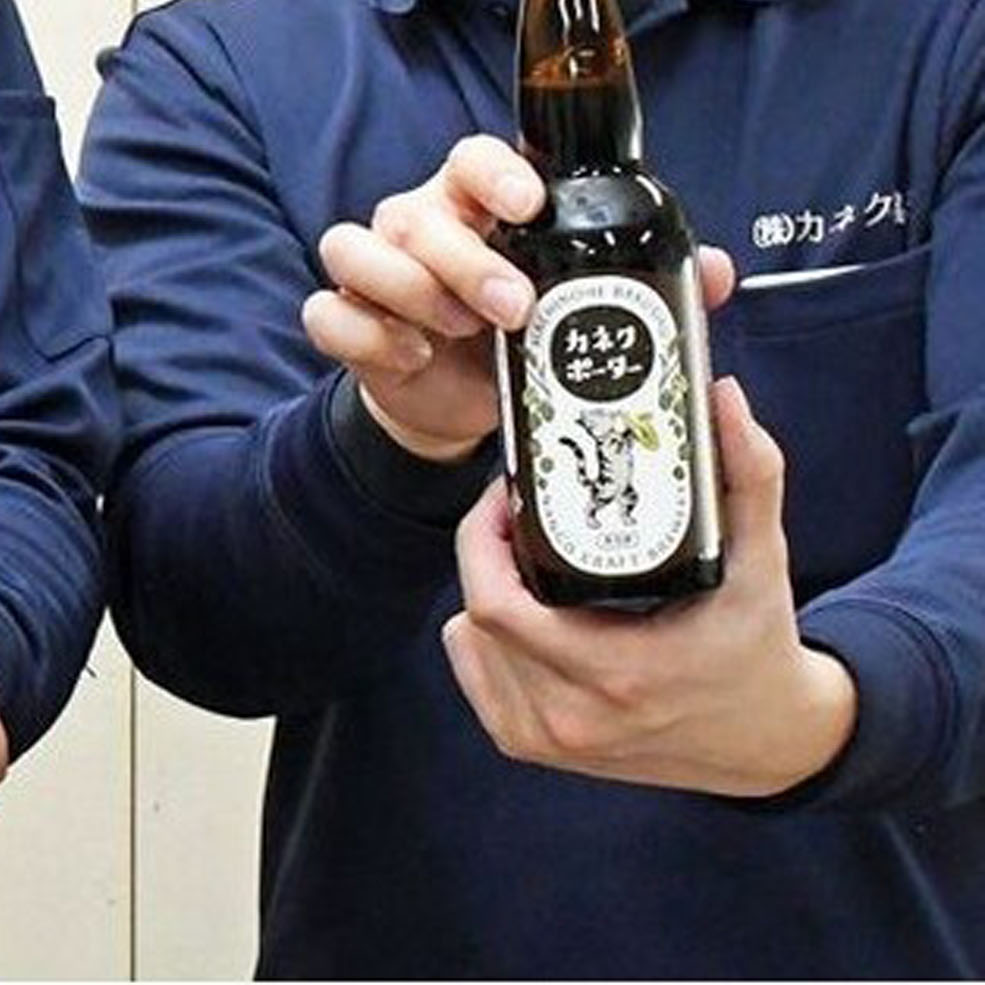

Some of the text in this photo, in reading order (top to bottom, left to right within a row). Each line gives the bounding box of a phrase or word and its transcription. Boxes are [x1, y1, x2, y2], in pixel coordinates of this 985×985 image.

[565, 325, 637, 352] カネク
[566, 356, 643, 382] ポーター
